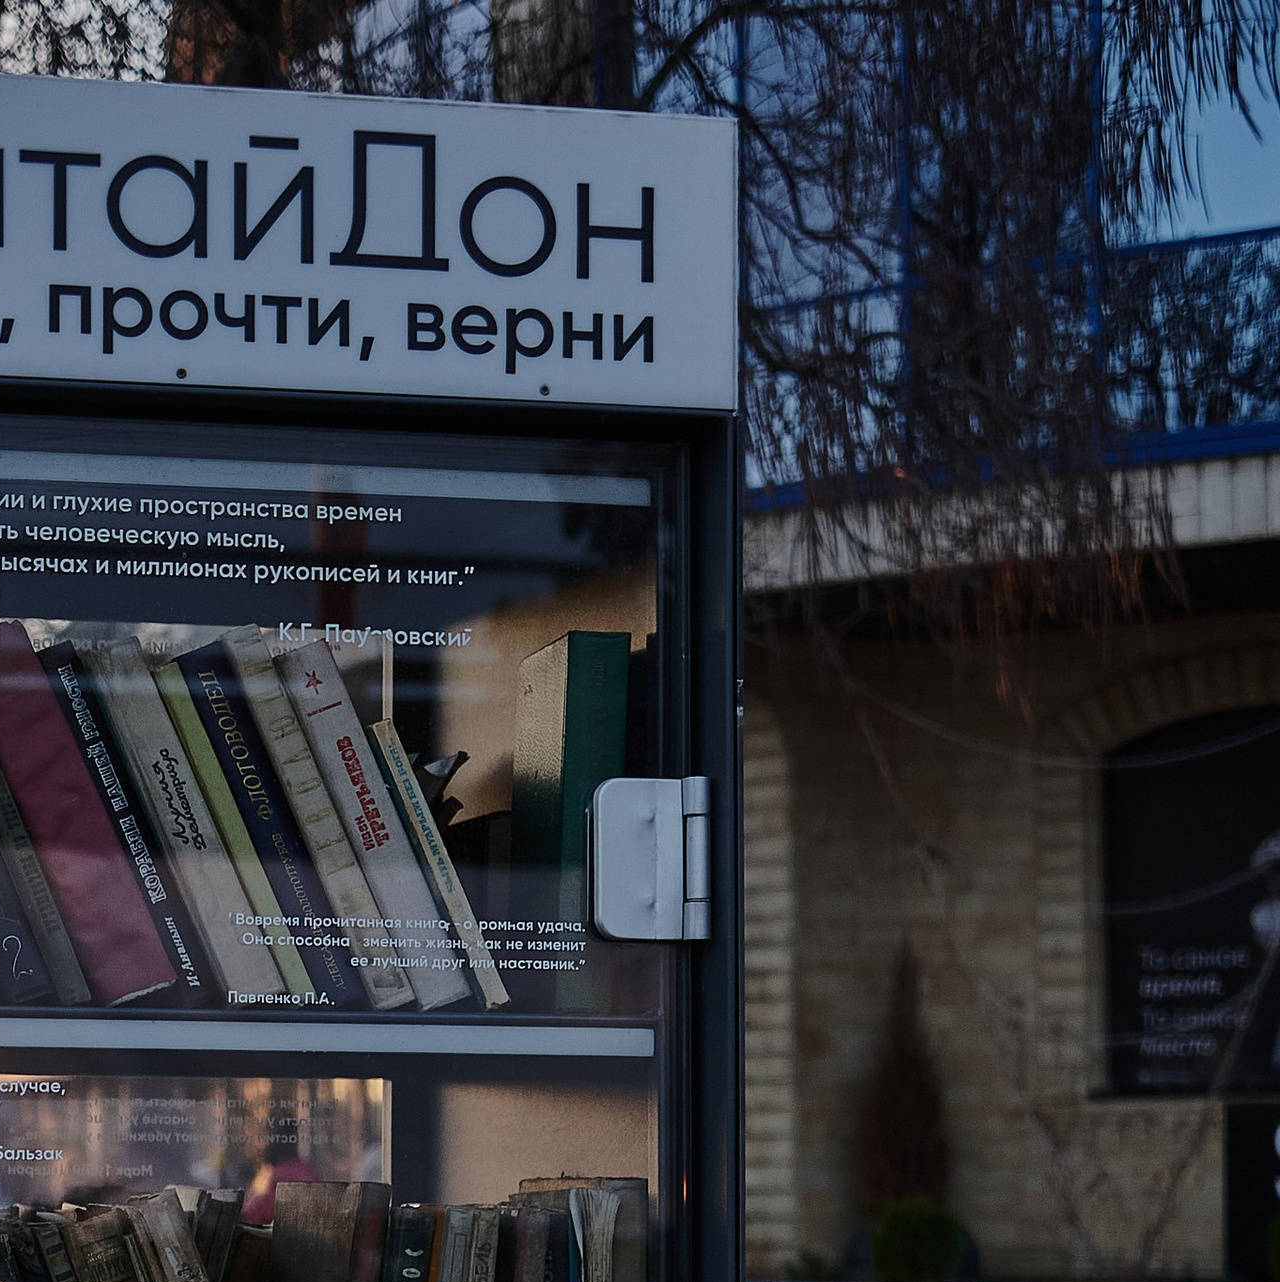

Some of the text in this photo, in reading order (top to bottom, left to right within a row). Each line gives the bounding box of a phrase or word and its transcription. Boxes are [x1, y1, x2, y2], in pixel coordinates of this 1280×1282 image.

[47, 282, 378, 363] прочти,
[406, 300, 658, 375] верни
[51, 493, 132, 516] глухие
[139, 497, 309, 527] пространства
[315, 503, 402, 527] времен
[25, 524, 200, 548] человеческую
[206, 532, 286, 553] мысль,
[116, 559, 248, 580] миллионах
[254, 561, 381, 584] рукописей
[197, 669, 273, 821] ФЛОТОВОДЕЦ
[56, 662, 167, 905] КОРАБЛИ НАШЕЙ ЮНОСТИ
[336, 735, 390, 848] ТРЕТЬЯКОВ
[304, 915, 586, 935] прочитанная удача.
[242, 933, 586, 952] Она способна не изменит
[350, 953, 466, 972] ее лучший друг
[227, 990, 301, 1005] Павленко
[0, 1079, 67, 1096] случае,
